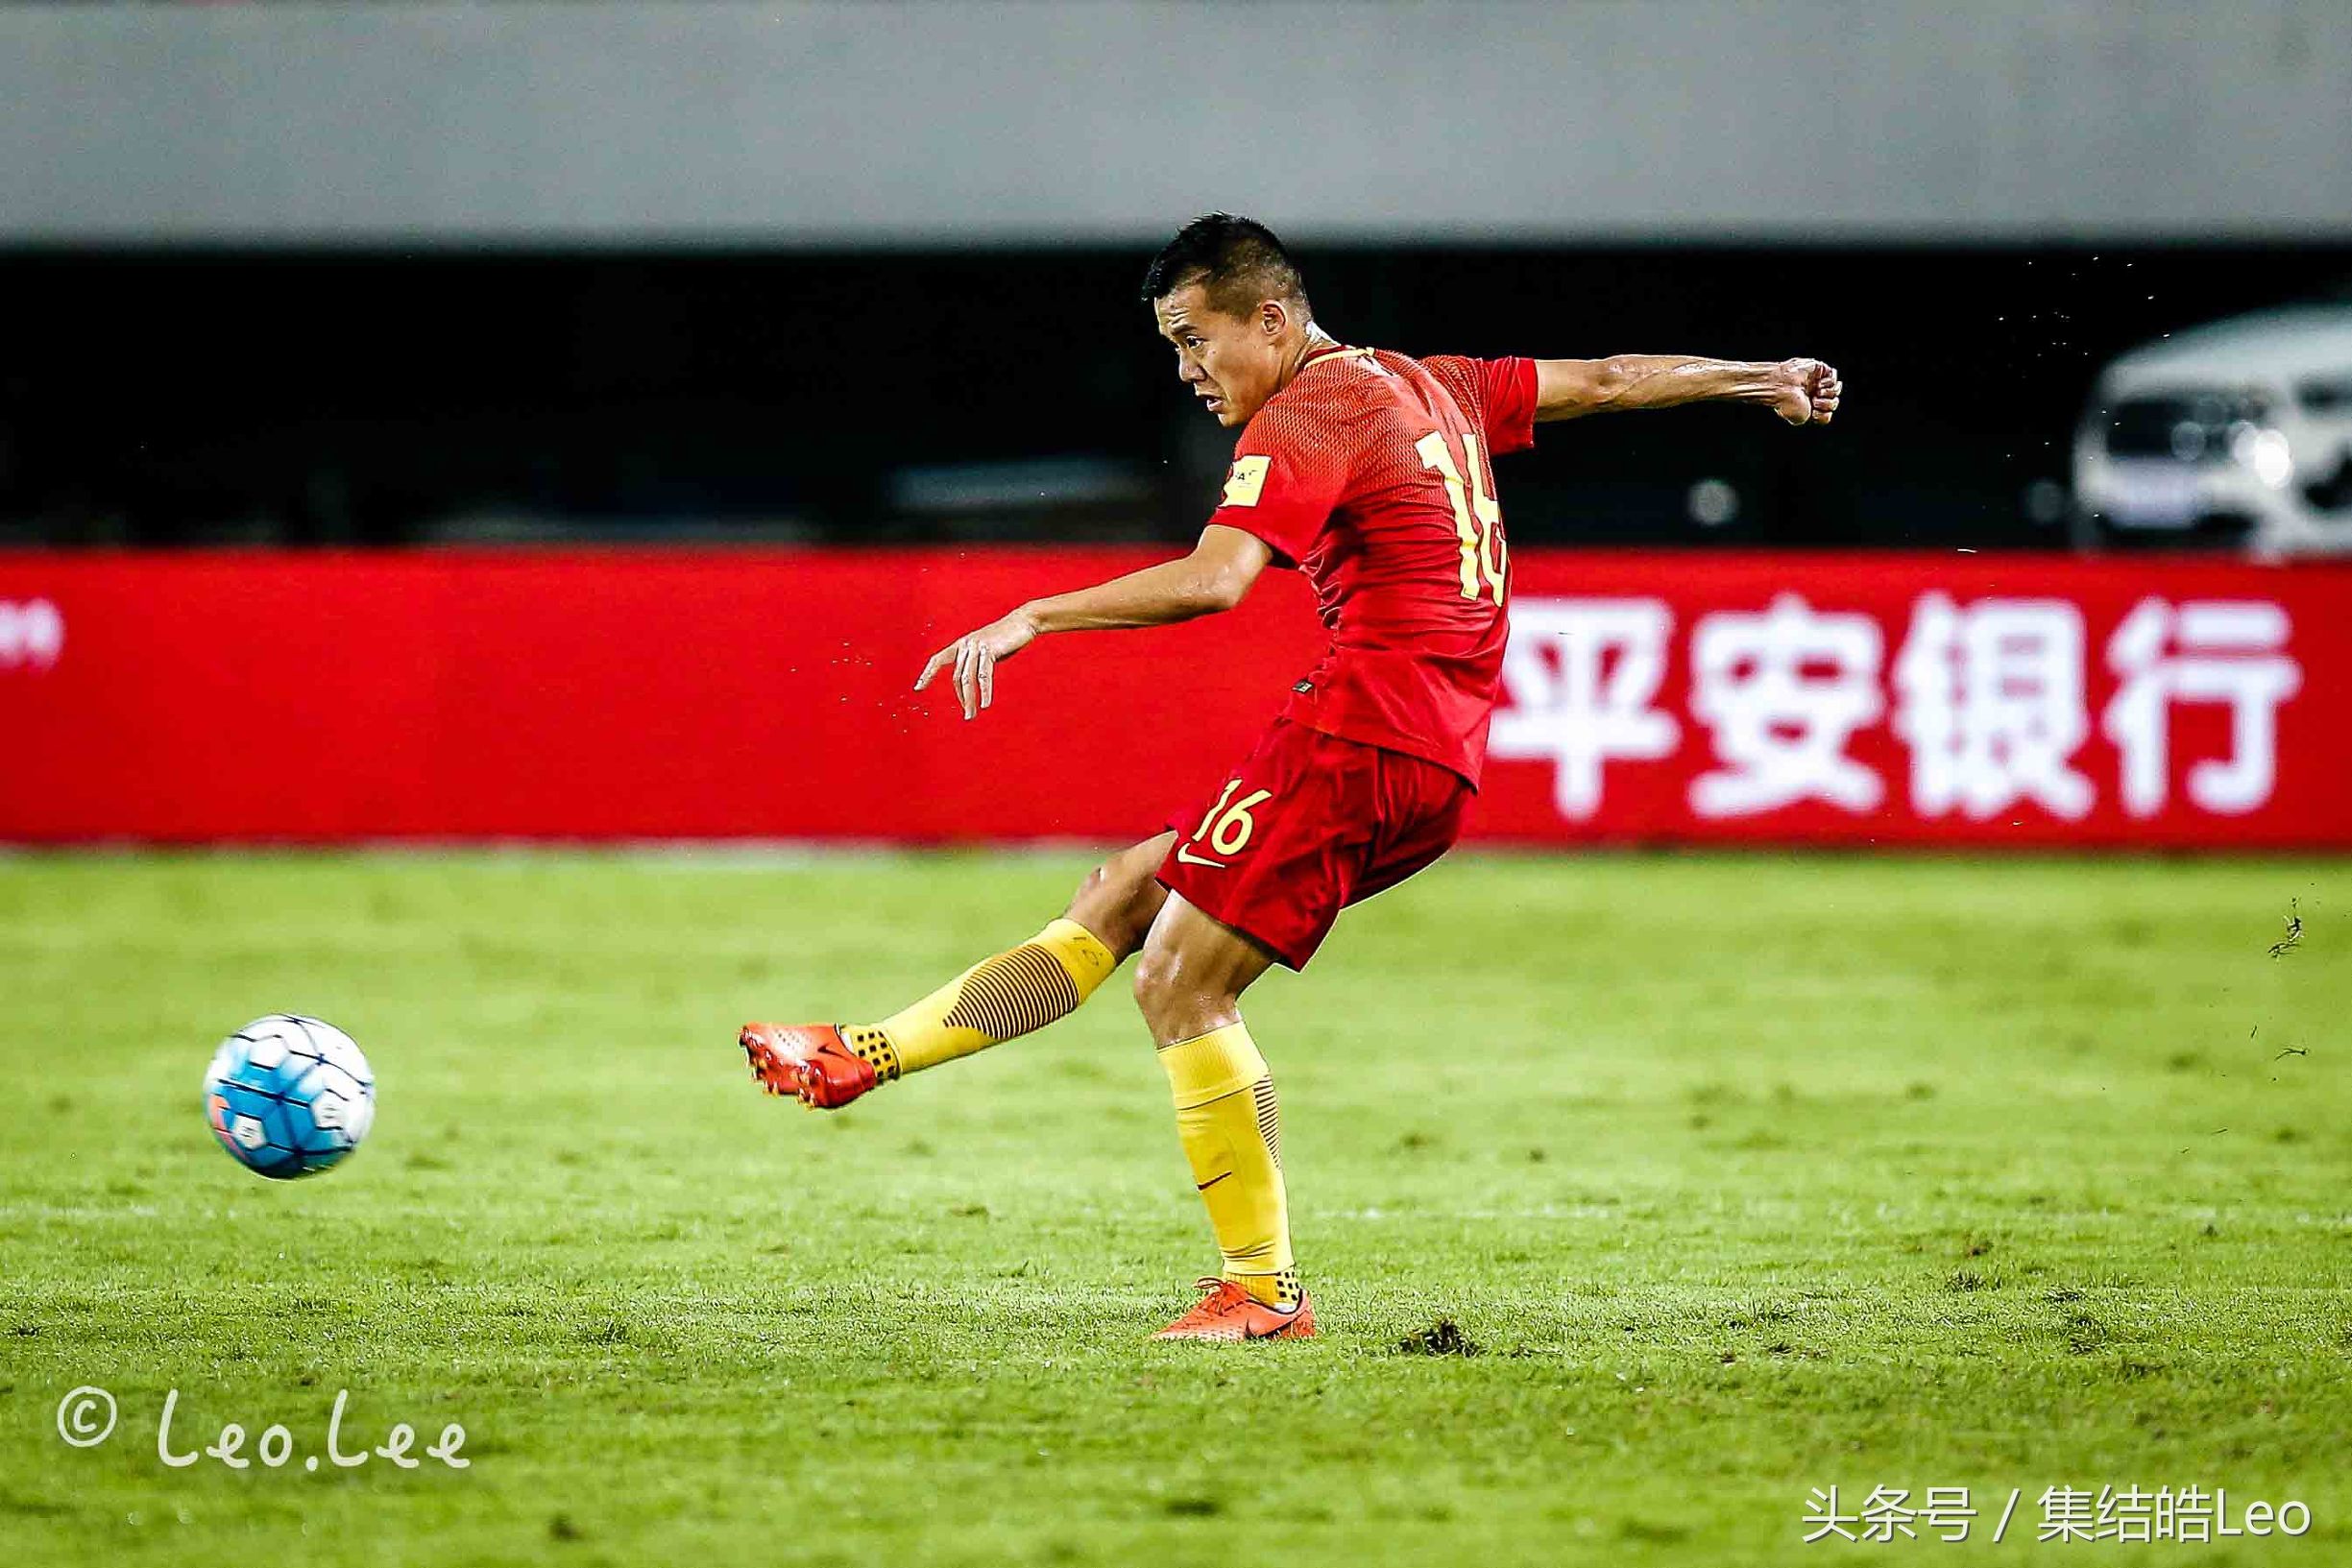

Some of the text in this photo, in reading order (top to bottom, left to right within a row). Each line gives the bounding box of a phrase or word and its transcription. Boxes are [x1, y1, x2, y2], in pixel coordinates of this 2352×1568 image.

[1415, 430, 1507, 608] 16
[1489, 592, 2303, 822] 平安银行
[1191, 779, 1273, 856] 16
